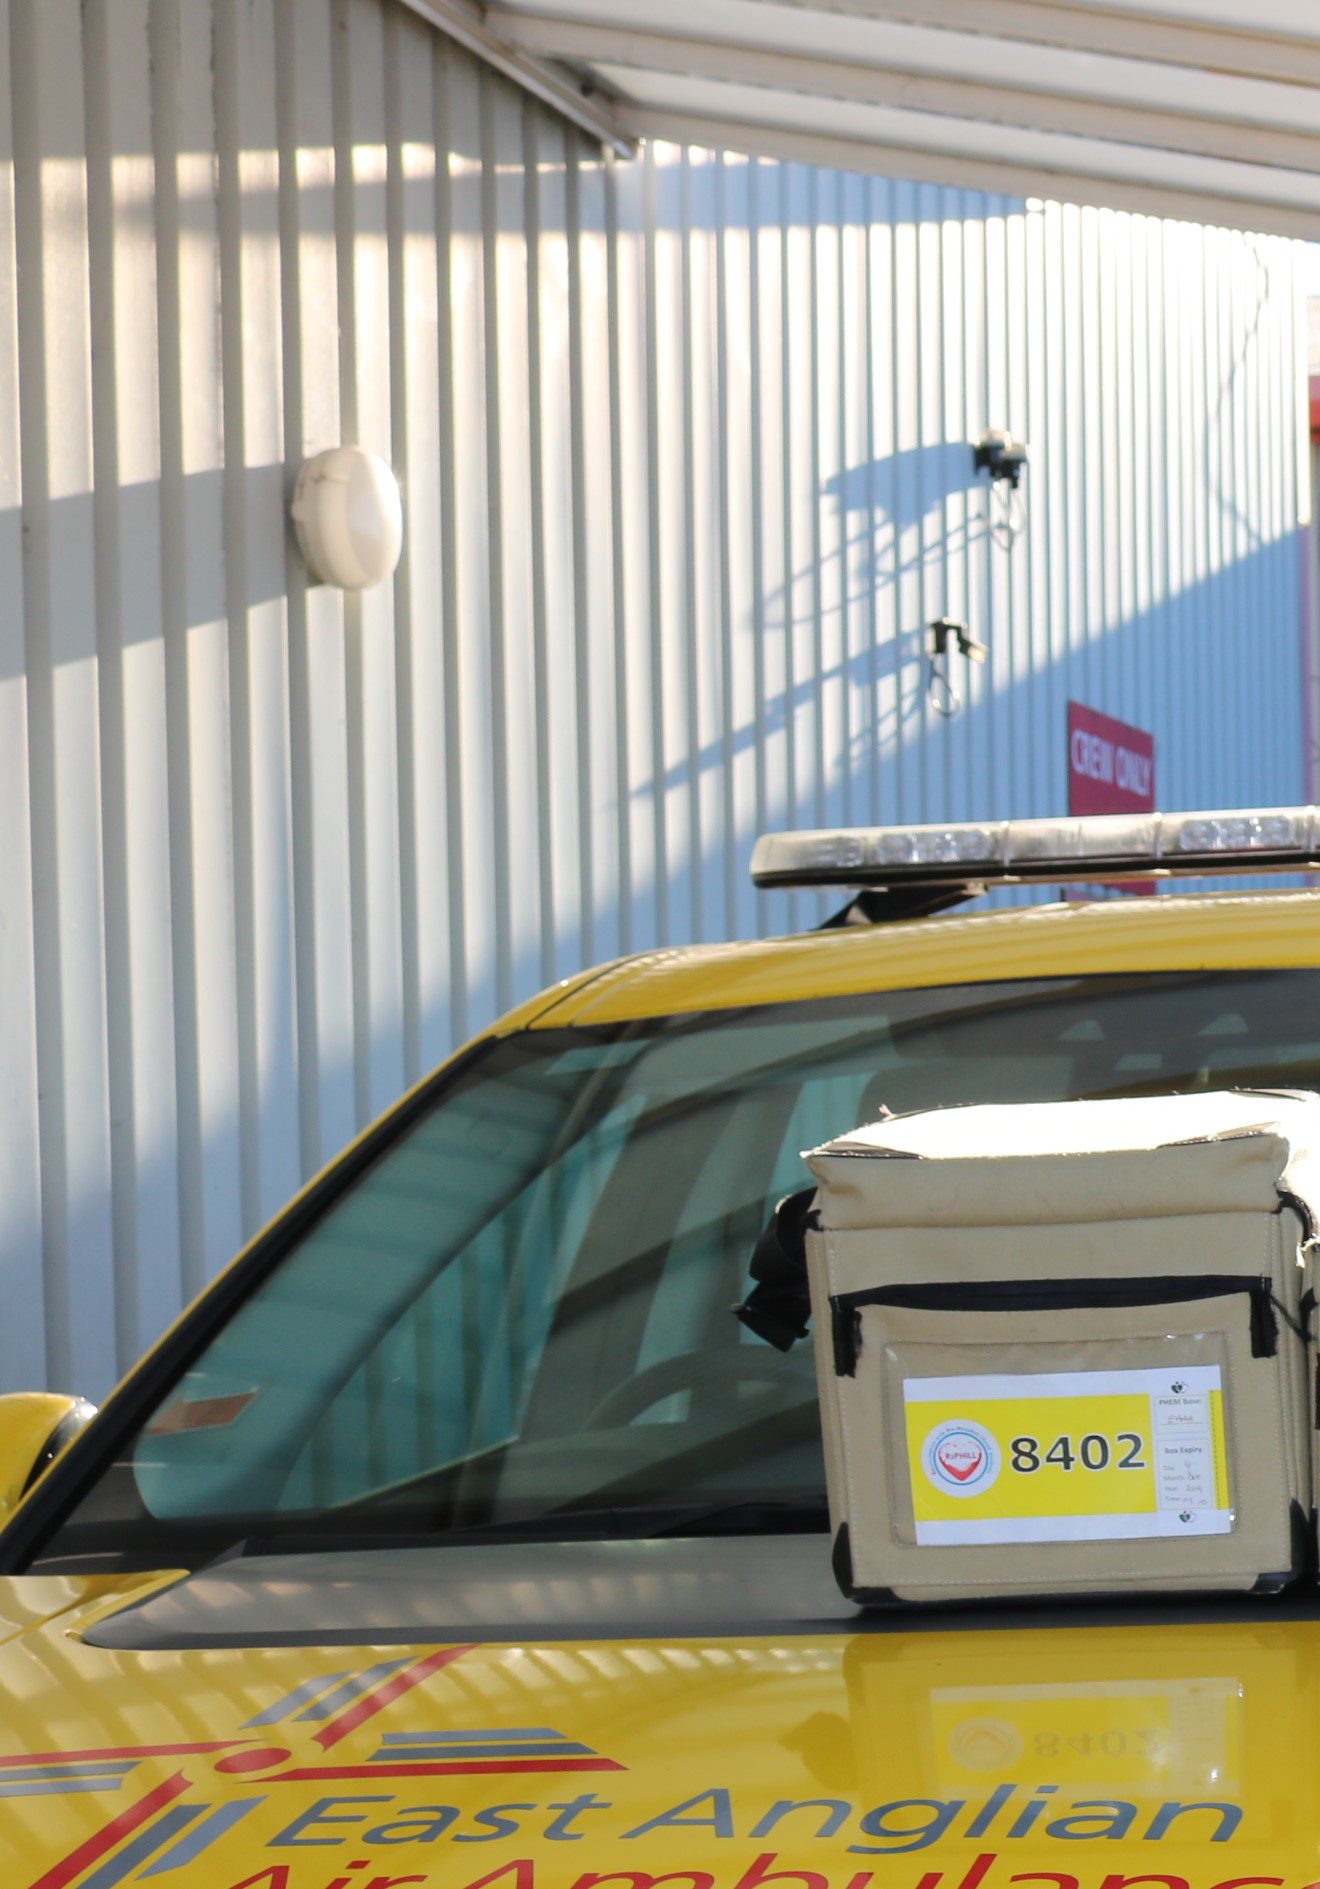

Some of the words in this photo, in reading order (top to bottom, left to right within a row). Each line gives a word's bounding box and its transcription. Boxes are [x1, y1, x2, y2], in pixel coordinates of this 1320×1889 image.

[1071, 729, 1115, 784] CREW
[1115, 745, 1152, 797] ONLY
[1011, 1433, 1145, 1473] 8402
[264, 1793, 612, 1847] East
[618, 1784, 1243, 1854] Anglian
